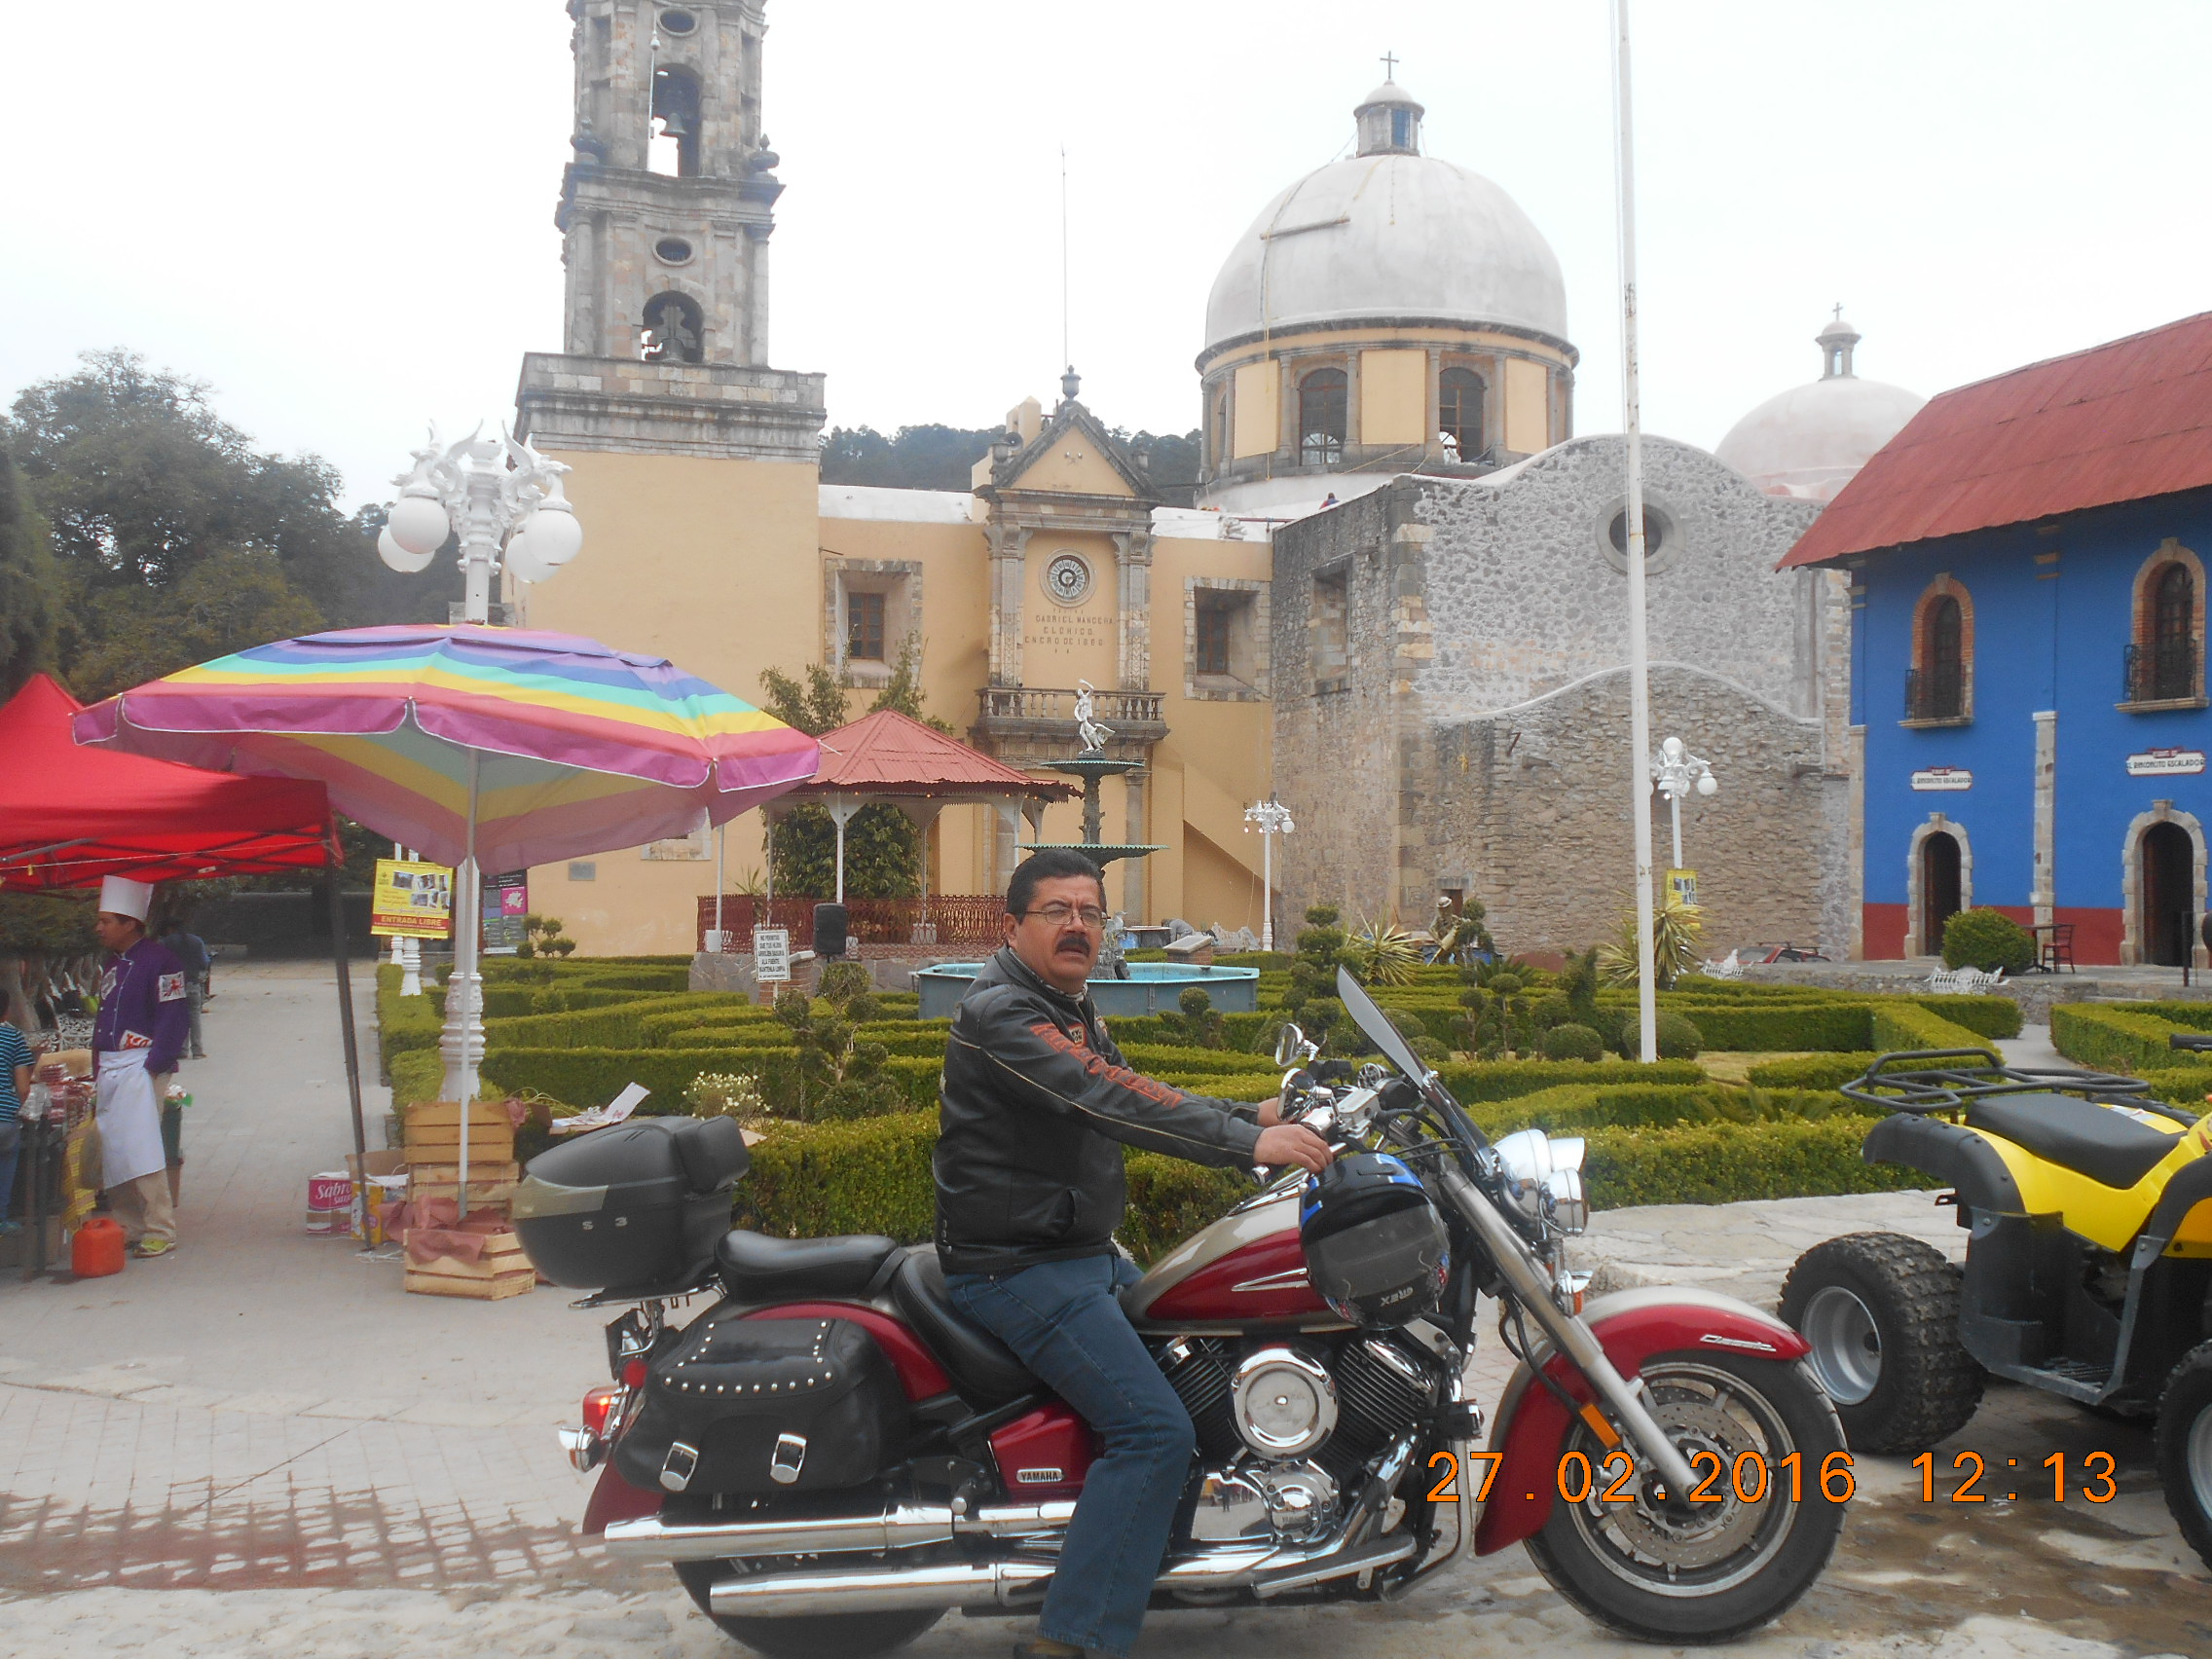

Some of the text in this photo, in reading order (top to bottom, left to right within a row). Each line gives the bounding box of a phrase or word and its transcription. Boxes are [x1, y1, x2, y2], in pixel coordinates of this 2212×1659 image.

[381, 915, 417, 925] ENTRADA
[419, 918, 442, 927] LIBRE
[1020, 1470, 1059, 1481] YAMAHA
